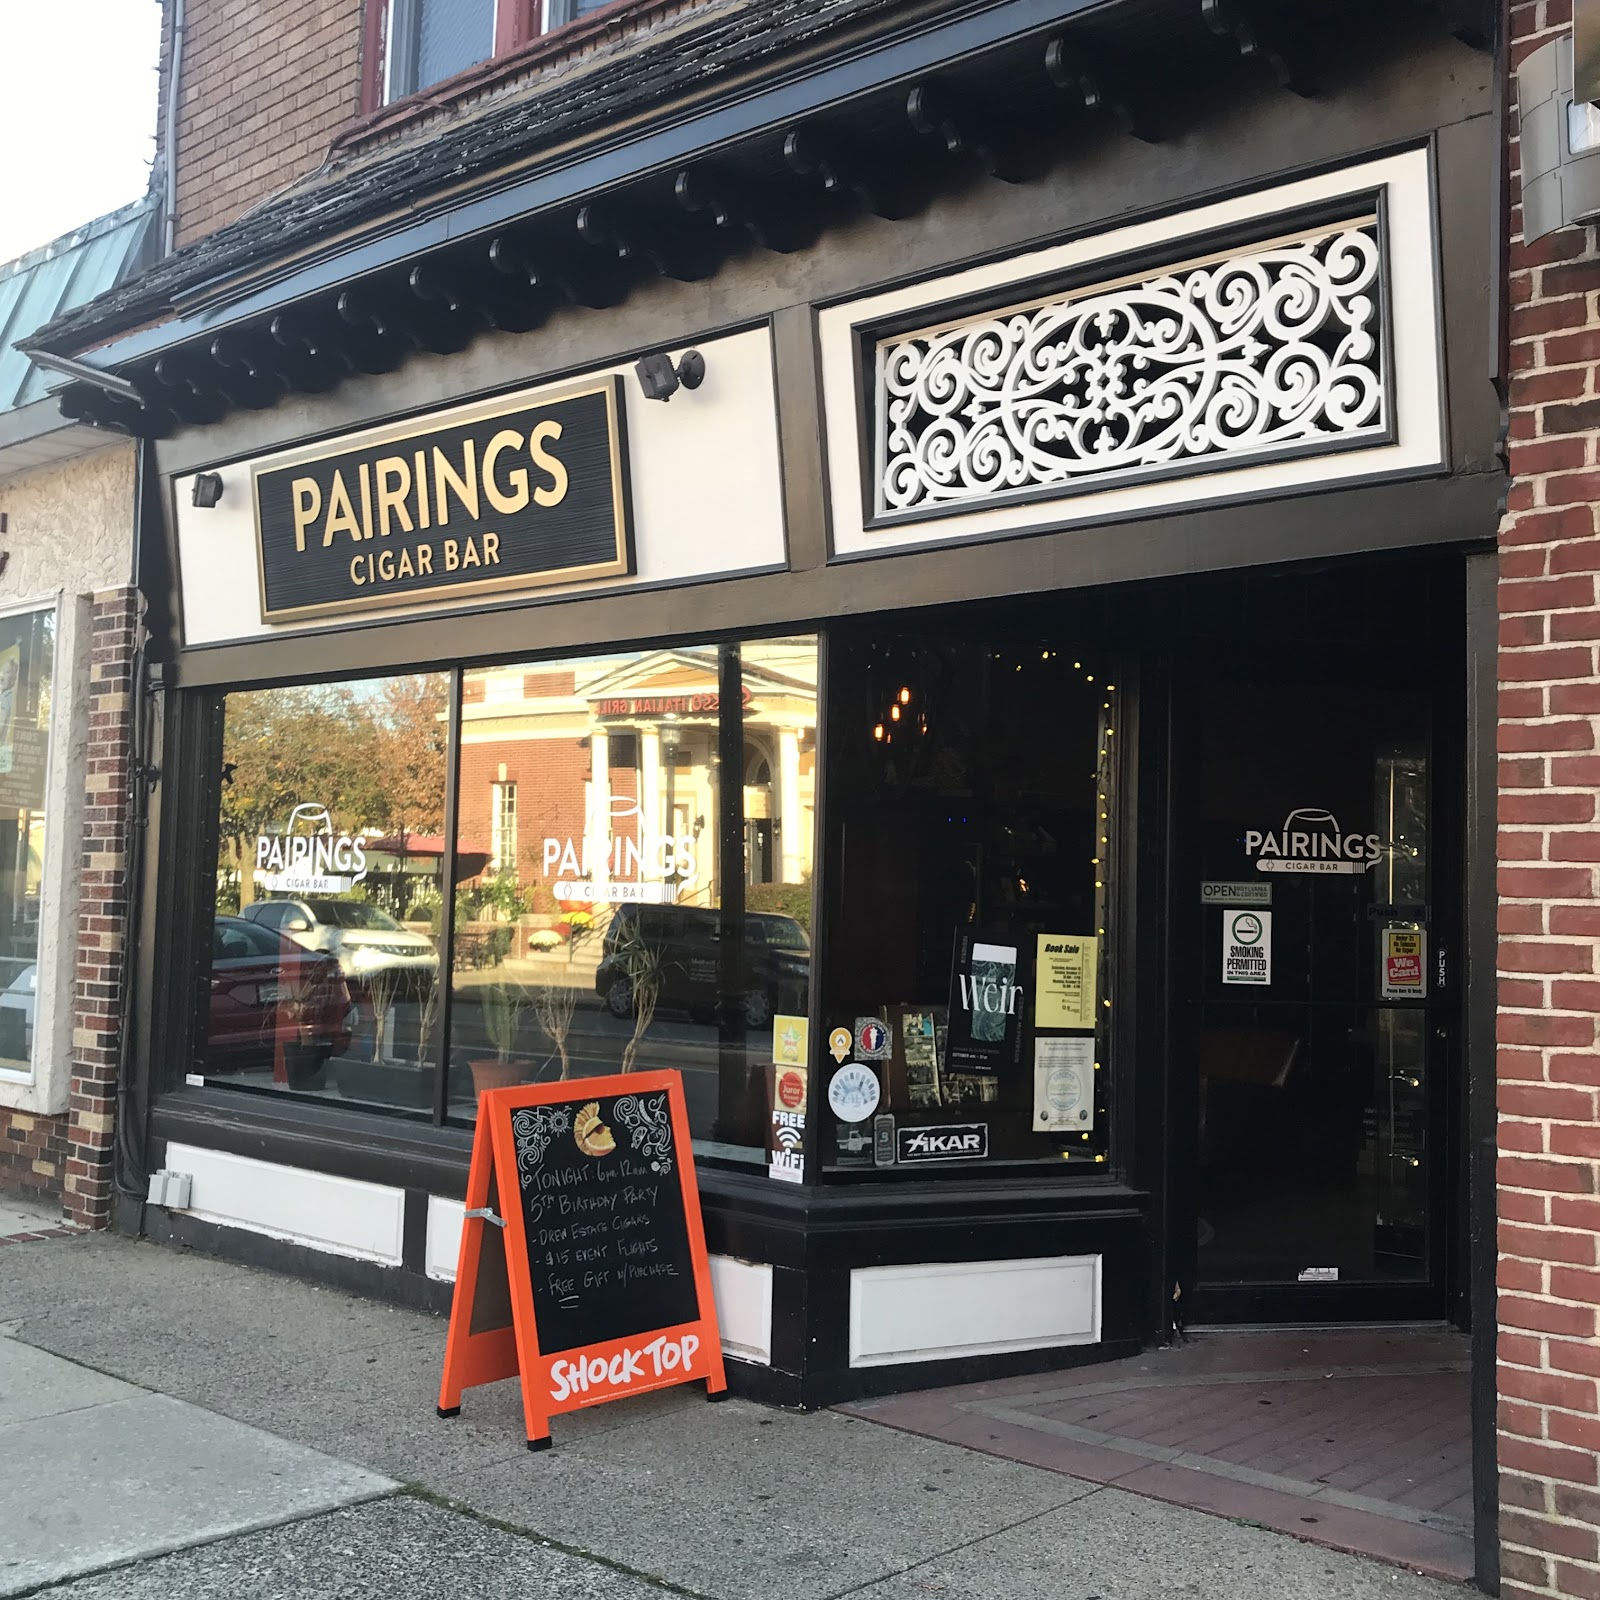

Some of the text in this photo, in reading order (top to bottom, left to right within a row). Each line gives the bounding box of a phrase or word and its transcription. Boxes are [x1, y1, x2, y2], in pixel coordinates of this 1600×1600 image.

[291, 420, 569, 553] PAIRINGS
[350, 532, 501, 586] CIGAR BAR
[256, 836, 367, 872] PAIRINGS
[542, 835, 697, 877] PAIRINGS
[1245, 830, 1381, 860] PAIRINGS
[1285, 862, 1338, 871] CIGAR BAR
[286, 878, 329, 889] CIGAR BAR
[584, 887, 618, 897] CIAR
[1203, 885, 1237, 897] OPEN
[1044, 943, 1080, 954] Book Sale
[1230, 945, 1264, 958] SMOKING
[1227, 958, 1267, 971] PERMITTED
[1389, 966, 1420, 978] Card
[1393, 958, 1414, 967] We
[1438, 950, 1446, 985] PUSH
[959, 974, 1023, 1015] Weir
[782, 1085, 800, 1095] Juror
[772, 1110, 806, 1129] FREE
[771, 1148, 805, 1170] WiFi
[558, 1193, 618, 1215] BIRTHDAY
[623, 1185, 658, 1207] PARTY
[539, 1214, 650, 1246] DREW ESTATE CIGARS
[545, 1238, 659, 1266] $15 EVENT FLIGHTS
[547, 1272, 575, 1296] FREE
[583, 1270, 610, 1288] GIFT
[549, 1347, 646, 1402] SHOCK
[642, 1334, 700, 1377] TOP
